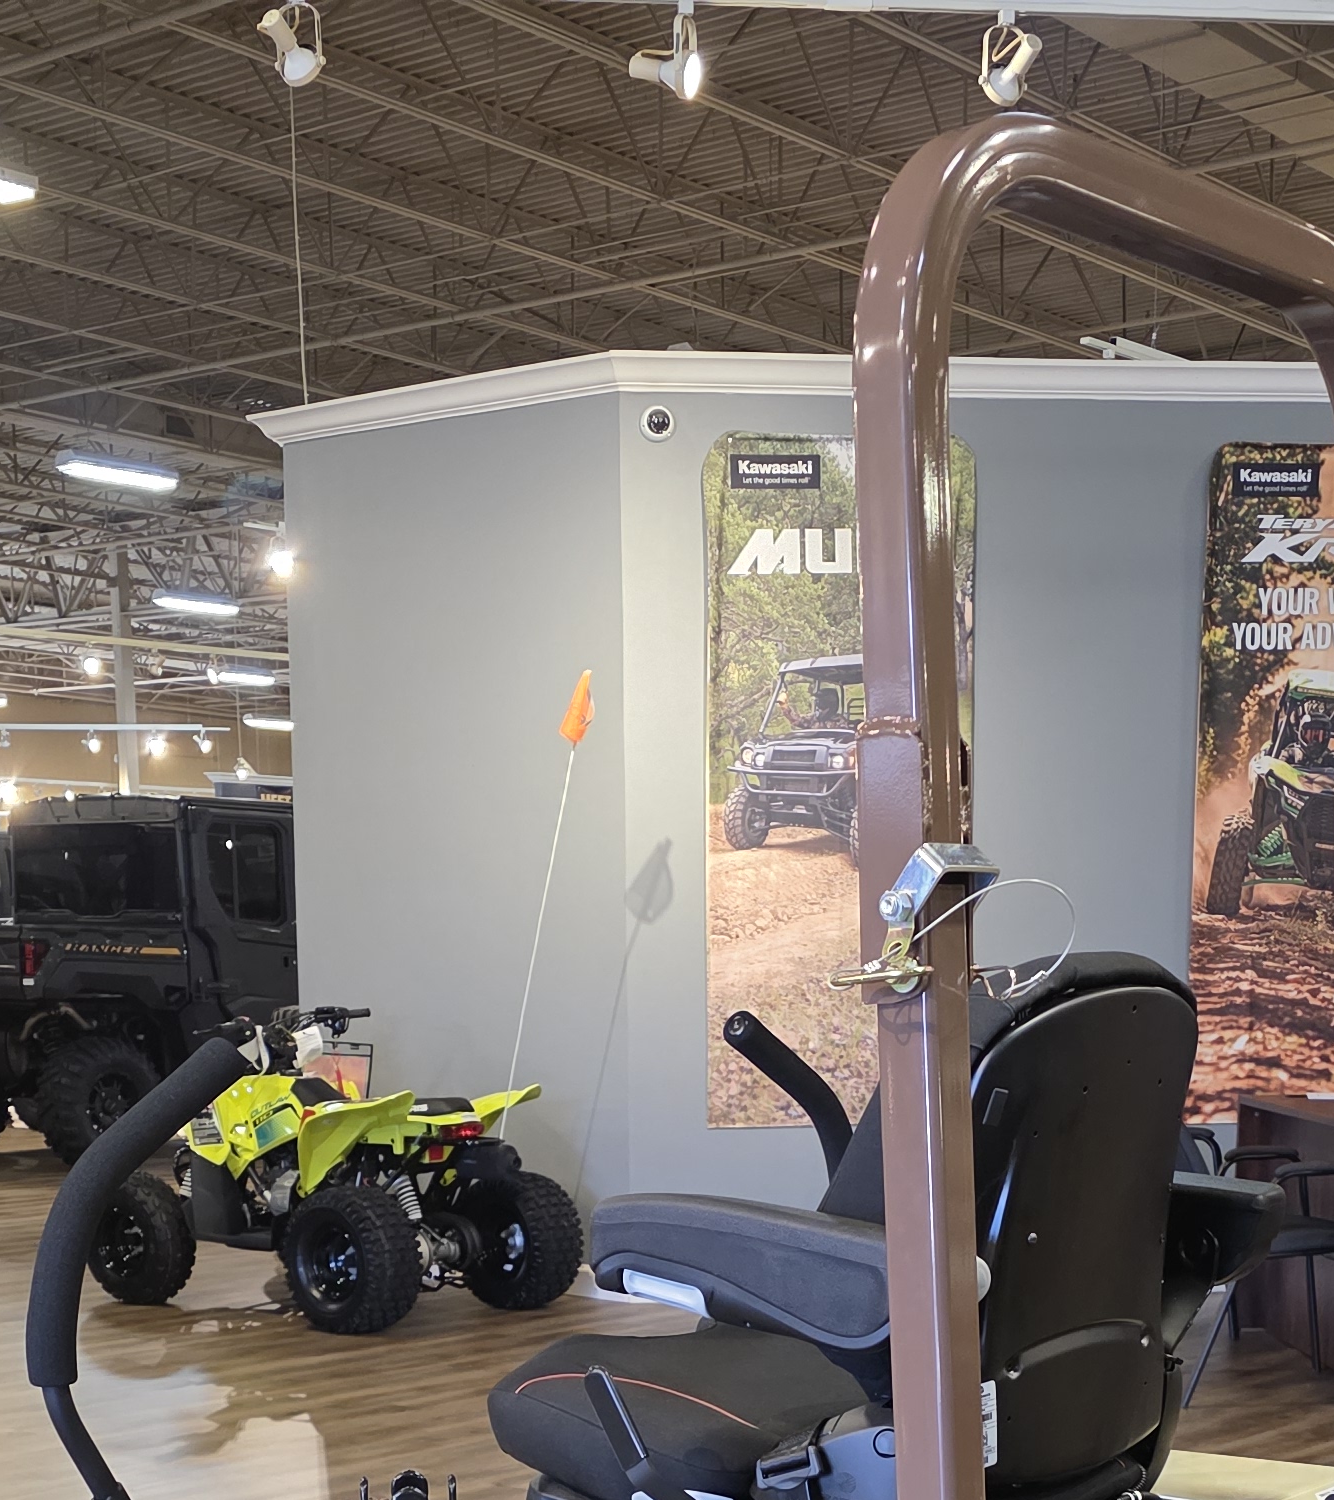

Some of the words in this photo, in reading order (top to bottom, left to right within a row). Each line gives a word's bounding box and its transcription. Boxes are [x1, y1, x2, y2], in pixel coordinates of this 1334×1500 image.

[738, 460, 813, 475] Kawasaki
[1240, 468, 1312, 483] Kawasaki
[753, 477, 763, 485] the
[765, 477, 780, 487] good
[782, 477, 798, 485] times
[727, 528, 853, 575] MU
[1258, 587, 1319, 616] YOUR
[1232, 622, 1292, 650] YOUR
